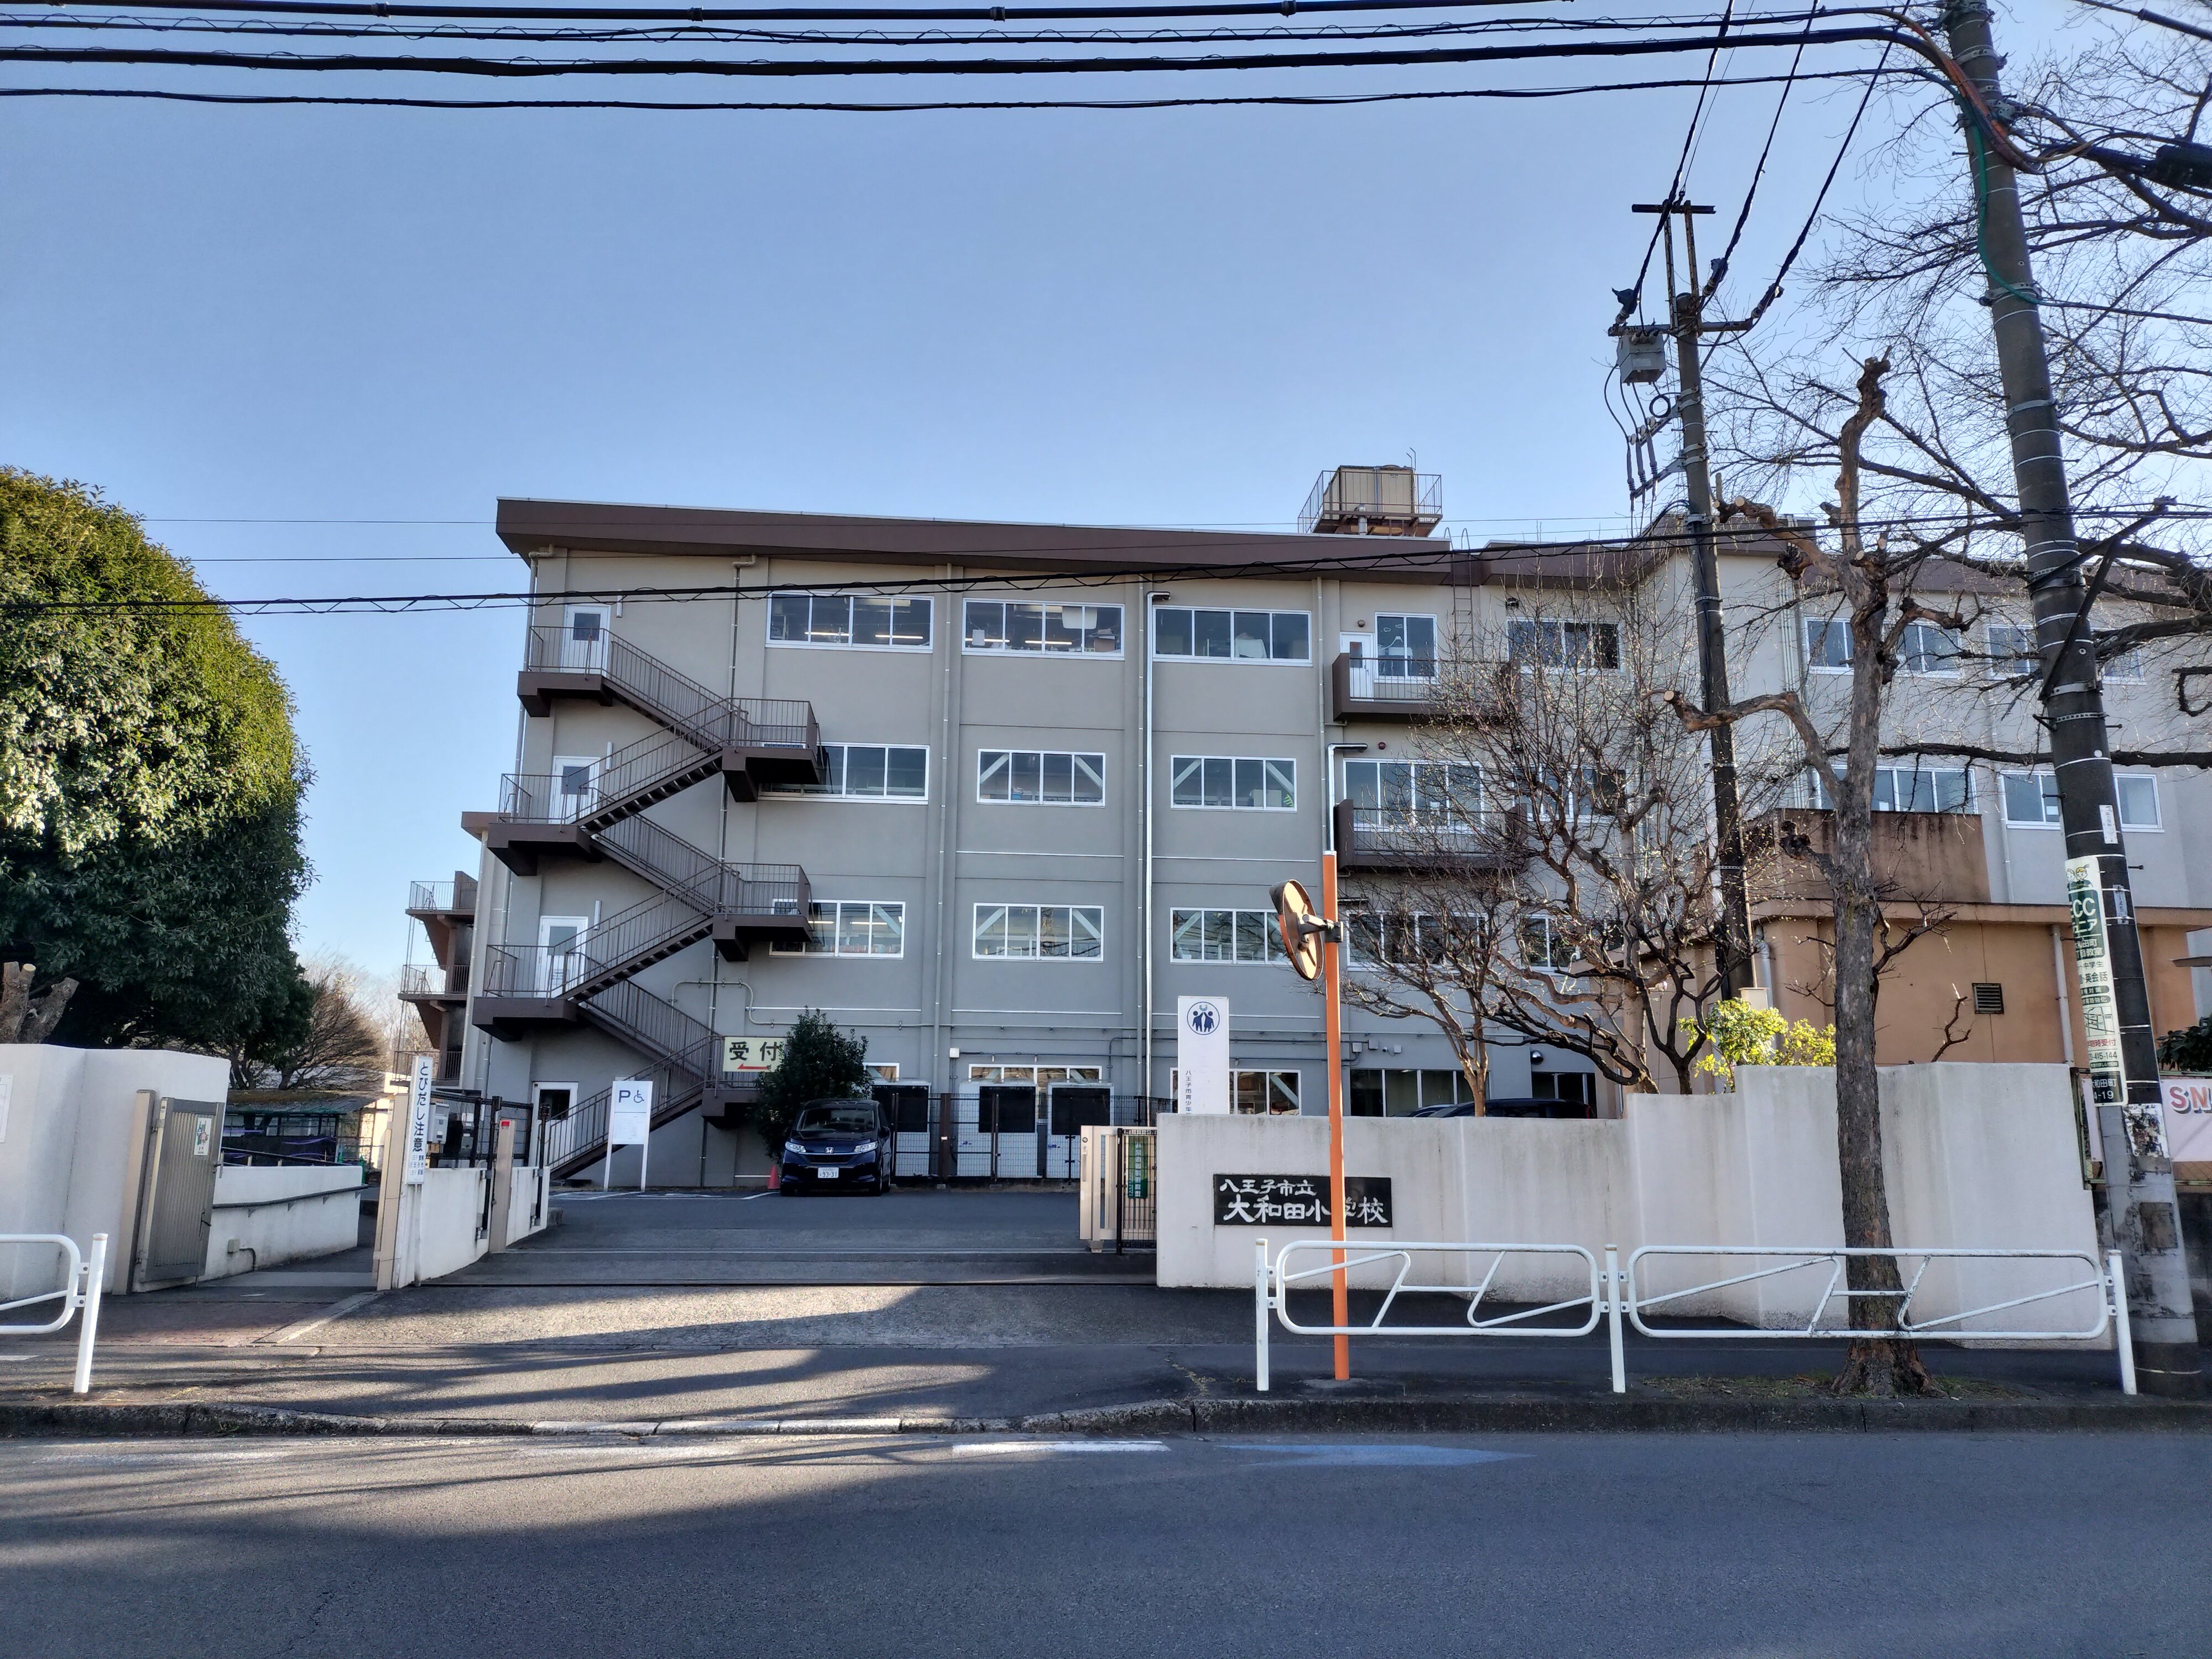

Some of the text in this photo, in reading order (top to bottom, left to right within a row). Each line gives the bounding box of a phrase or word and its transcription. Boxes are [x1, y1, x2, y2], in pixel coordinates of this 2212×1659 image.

[2070, 897, 2095, 919] CC
[729, 1041, 779, 1061] 受付
[413, 1062, 429, 1151] とびだし注意
[618, 1090, 631, 1103] P
[1219, 1179, 1317, 1196] 八王子市立
